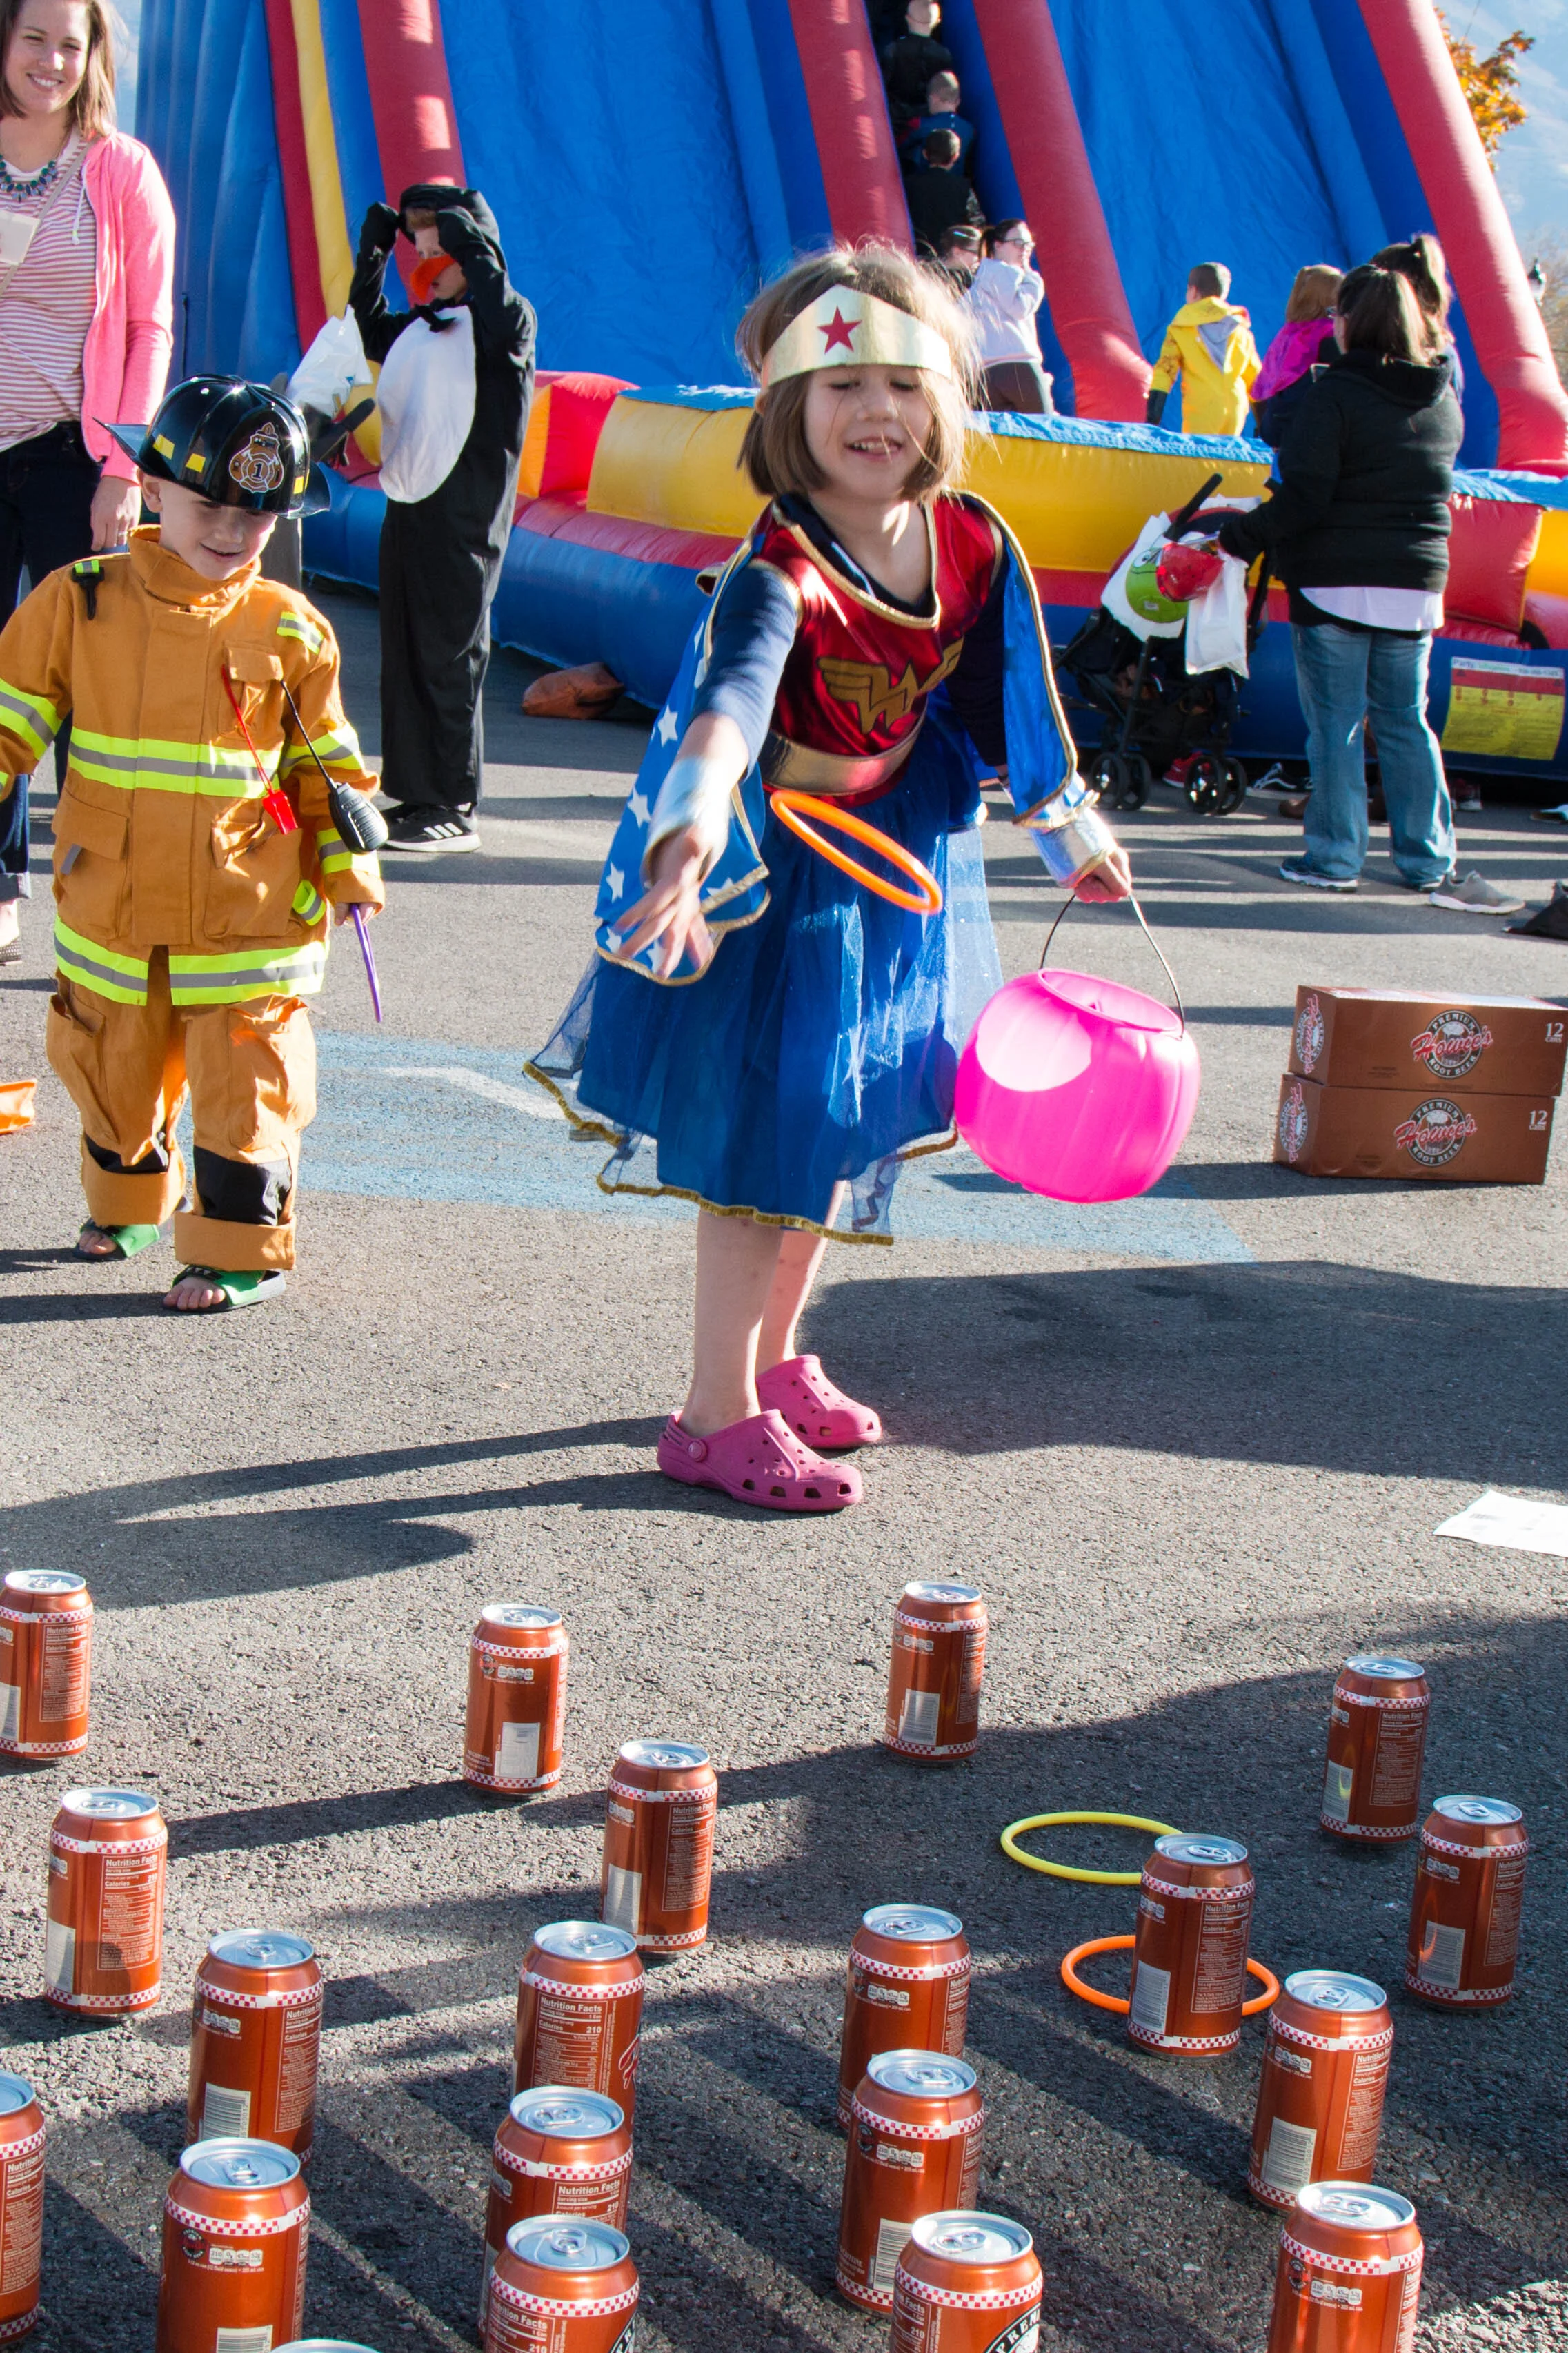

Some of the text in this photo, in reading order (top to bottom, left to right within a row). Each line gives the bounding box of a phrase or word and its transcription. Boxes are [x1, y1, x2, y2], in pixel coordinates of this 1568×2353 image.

[252, 463, 262, 479] 1
[1432, 1013, 1476, 1030] PREMIUM
[1546, 1023, 1564, 1037] 12
[1411, 1025, 1494, 1061] Howie's
[1429, 1055, 1477, 1075] ROOT BEER
[1416, 1102, 1459, 1119] PREMIUM
[1530, 1110, 1548, 1125] 12
[1394, 1114, 1477, 1149] Howie's
[1412, 1144, 1460, 1163] ROOT BEER
[106, 1859, 139, 1867] Nutrition
[541, 1996, 602, 2012] Nutrition Facts
[287, 2006, 315, 2019] Nutrition
[539, 2020, 563, 2031] Calories
[285, 2032, 307, 2040] Calories
[1358, 2051, 1385, 2063] Nutrition
[8, 2157, 38, 2172] Nutrition
[7, 2185, 30, 2196] Calories
[559, 2180, 619, 2195] Nutrition Facts
[607, 2201, 618, 2212] 210
[905, 2296, 925, 2314] Facts
[520, 2315, 547, 2330] Facts
[911, 2327, 924, 2339] 210
[529, 2344, 547, 2353] 210
